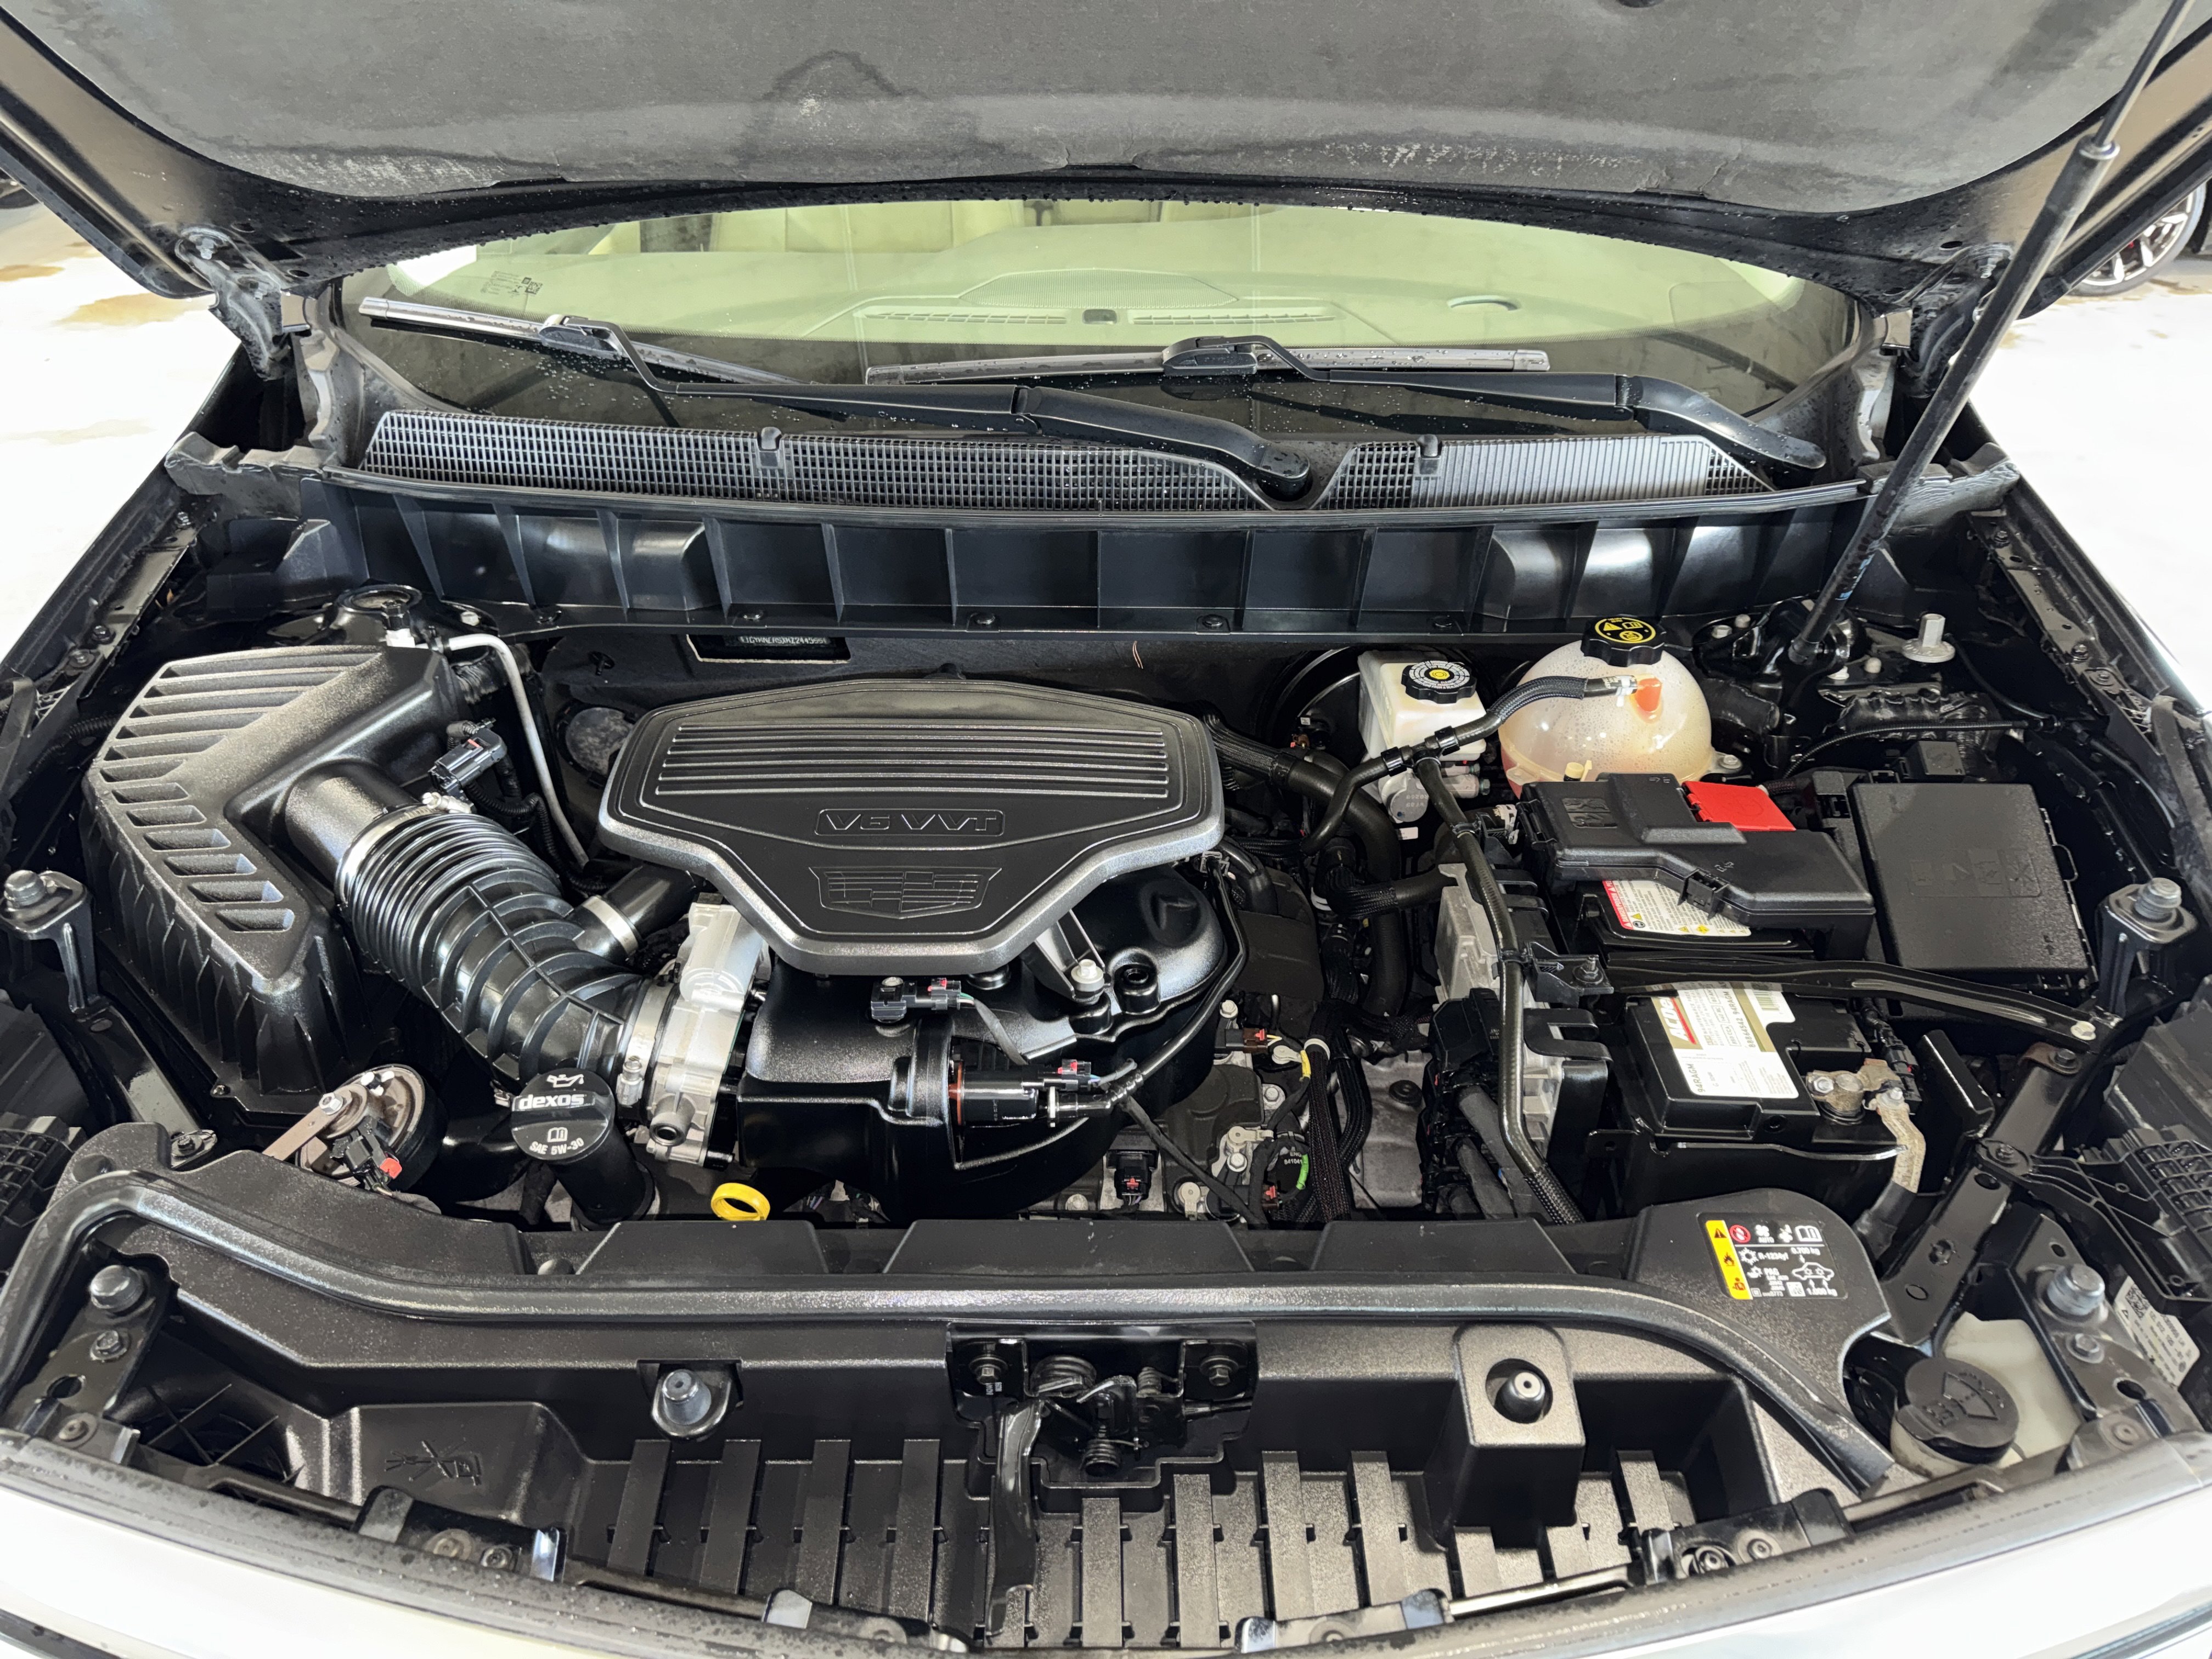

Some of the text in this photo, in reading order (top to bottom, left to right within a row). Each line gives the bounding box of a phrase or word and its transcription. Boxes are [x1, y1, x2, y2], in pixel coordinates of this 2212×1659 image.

[825, 813, 997, 831] V6 VVT
[1723, 991, 1740, 1015] 94RAGM
[1736, 1018, 1756, 1048] 88864542
[1686, 1063, 1704, 1093] 94RAGM
[519, 1094, 585, 1110] dexos
[529, 1137, 584, 1155] SAE 5W-30
[1757, 1252, 1789, 1261] R-1234yf
[1810, 1247, 1821, 1255] kg
